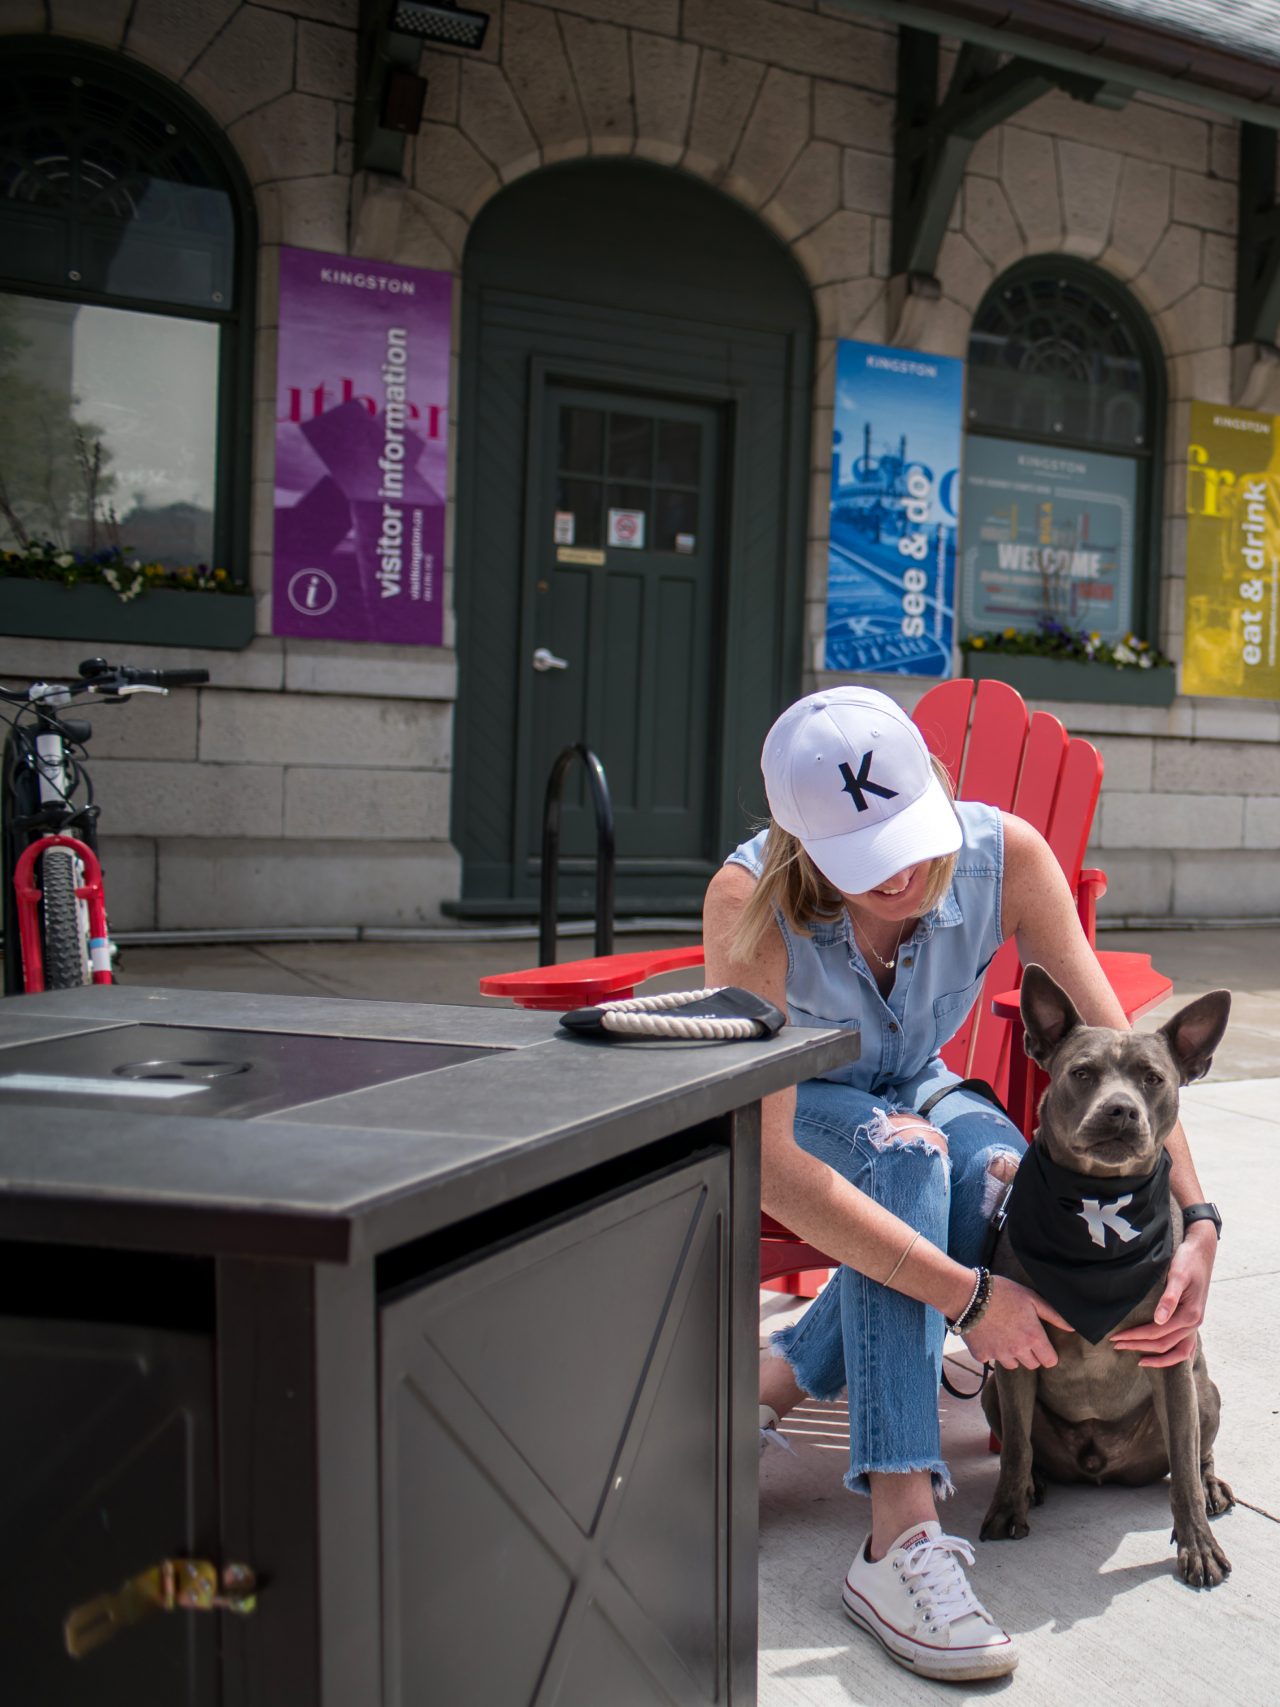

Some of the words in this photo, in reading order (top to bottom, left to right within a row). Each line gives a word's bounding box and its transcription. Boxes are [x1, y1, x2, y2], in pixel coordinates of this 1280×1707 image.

[320, 268, 416, 295] KINGSTON
[866, 355, 937, 378] KINGSTON
[378, 328, 407, 498] information
[1017, 455, 1087, 474] KINGSTON
[900, 465, 931, 523] do
[375, 503, 404, 599] visitor
[898, 532, 929, 561] &
[1241, 481, 1267, 570] drink
[998, 543, 1101, 579] WELCOME
[901, 568, 928, 639] see
[1240, 577, 1265, 603] &
[1241, 609, 1264, 666] eat
[838, 749, 899, 812] K
[1077, 1193, 1142, 1248] K
